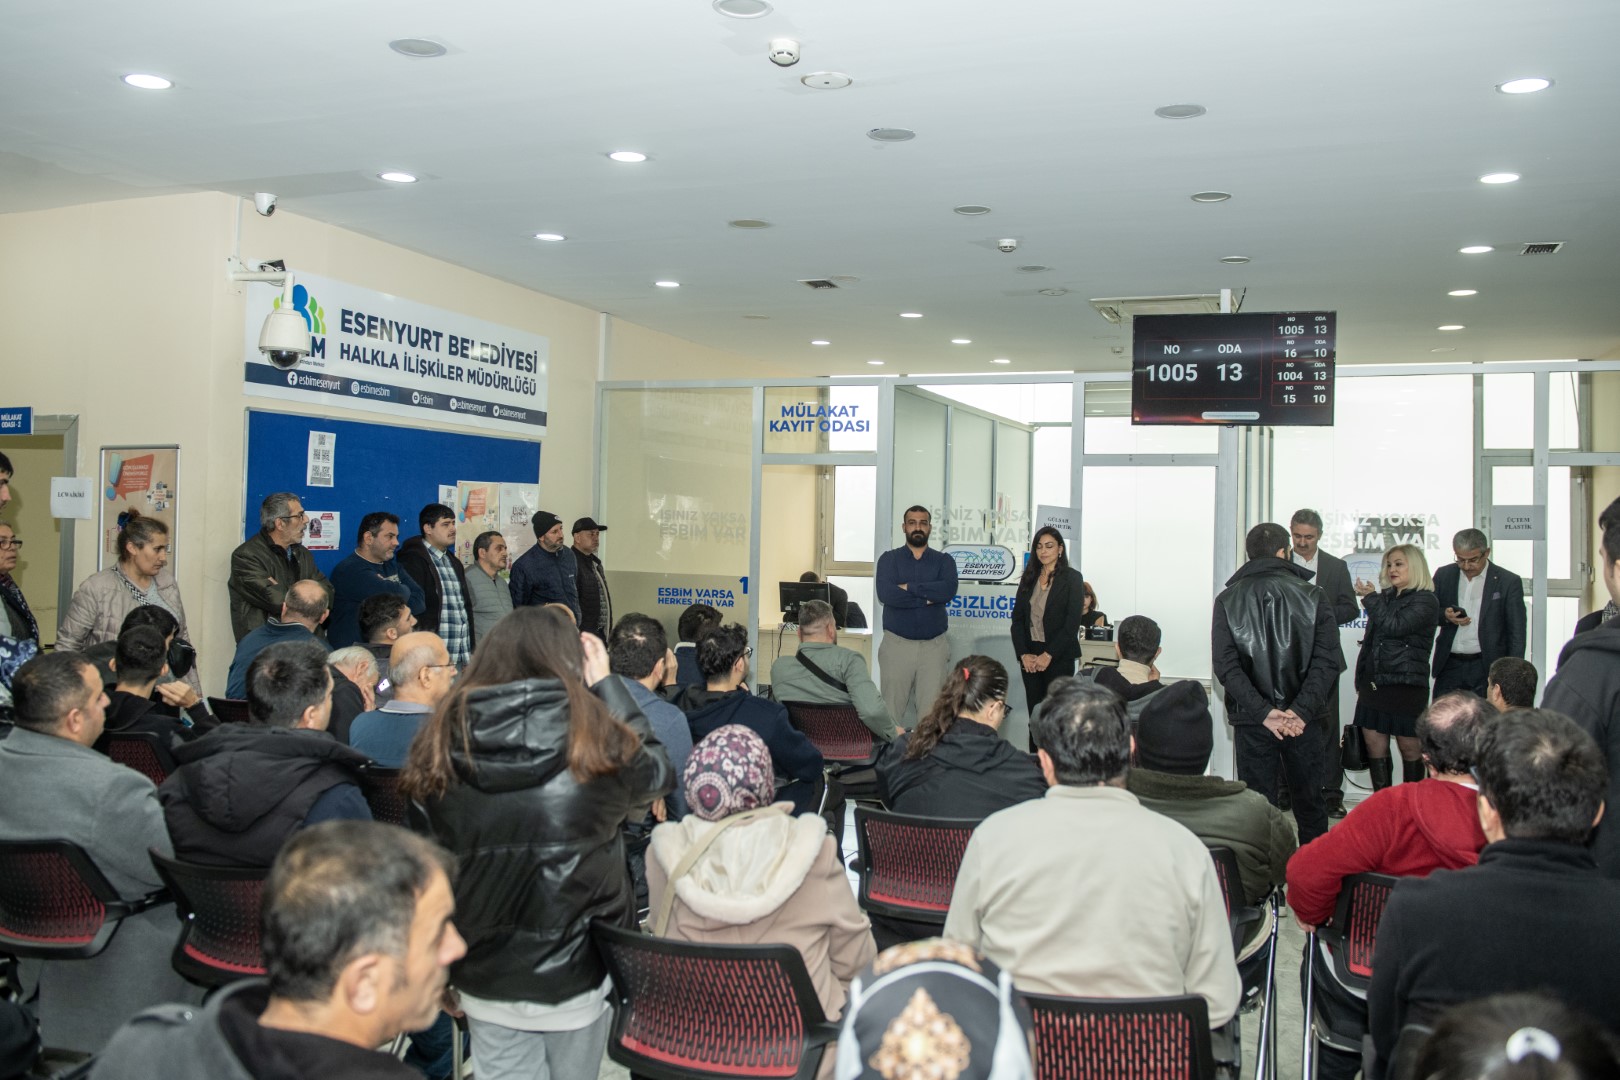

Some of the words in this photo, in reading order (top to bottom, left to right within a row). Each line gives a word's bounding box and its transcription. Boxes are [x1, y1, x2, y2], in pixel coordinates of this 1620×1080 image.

[1278, 325, 1304, 335] 1005
[1314, 325, 1327, 334] 13
[340, 308, 444, 352] ESENYURT
[449, 333, 539, 374] BELEDİYESİ
[1163, 344, 1180, 355] NO
[1217, 343, 1242, 354] ODA
[1284, 349, 1297, 358] 16
[1314, 348, 1327, 358] 10
[340, 342, 399, 370] HALKLA
[403, 352, 463, 382] İLİŞKİLER
[467, 367, 537, 397] MÜDÜRLÜĞÜ
[1146, 363, 1198, 382] 1005
[1216, 363, 1243, 382] 13
[1277, 371, 1303, 381] 1004
[1313, 371, 1327, 381] 13
[298, 374, 341, 391] esbimesenyurt
[360, 384, 391, 397] esbimesbim
[1283, 394, 1296, 404] 15
[1312, 394, 1326, 404] 10
[1, 412, 23, 421] MÜLAKAT
[781, 402, 859, 418] MÜLAKAT
[769, 420, 814, 433] KAYIT
[819, 420, 870, 433] ODASI
[1376, 513, 1440, 527] YOKSA
[1391, 532, 1440, 549] VAR
[738, 577, 749, 594] 1
[695, 588, 735, 600] VARSA
[658, 597, 692, 605] HERKES
[715, 600, 735, 608] VAR
[945, 595, 1017, 610] SİZLİĞE
[964, 610, 1012, 619] OLUYORU
